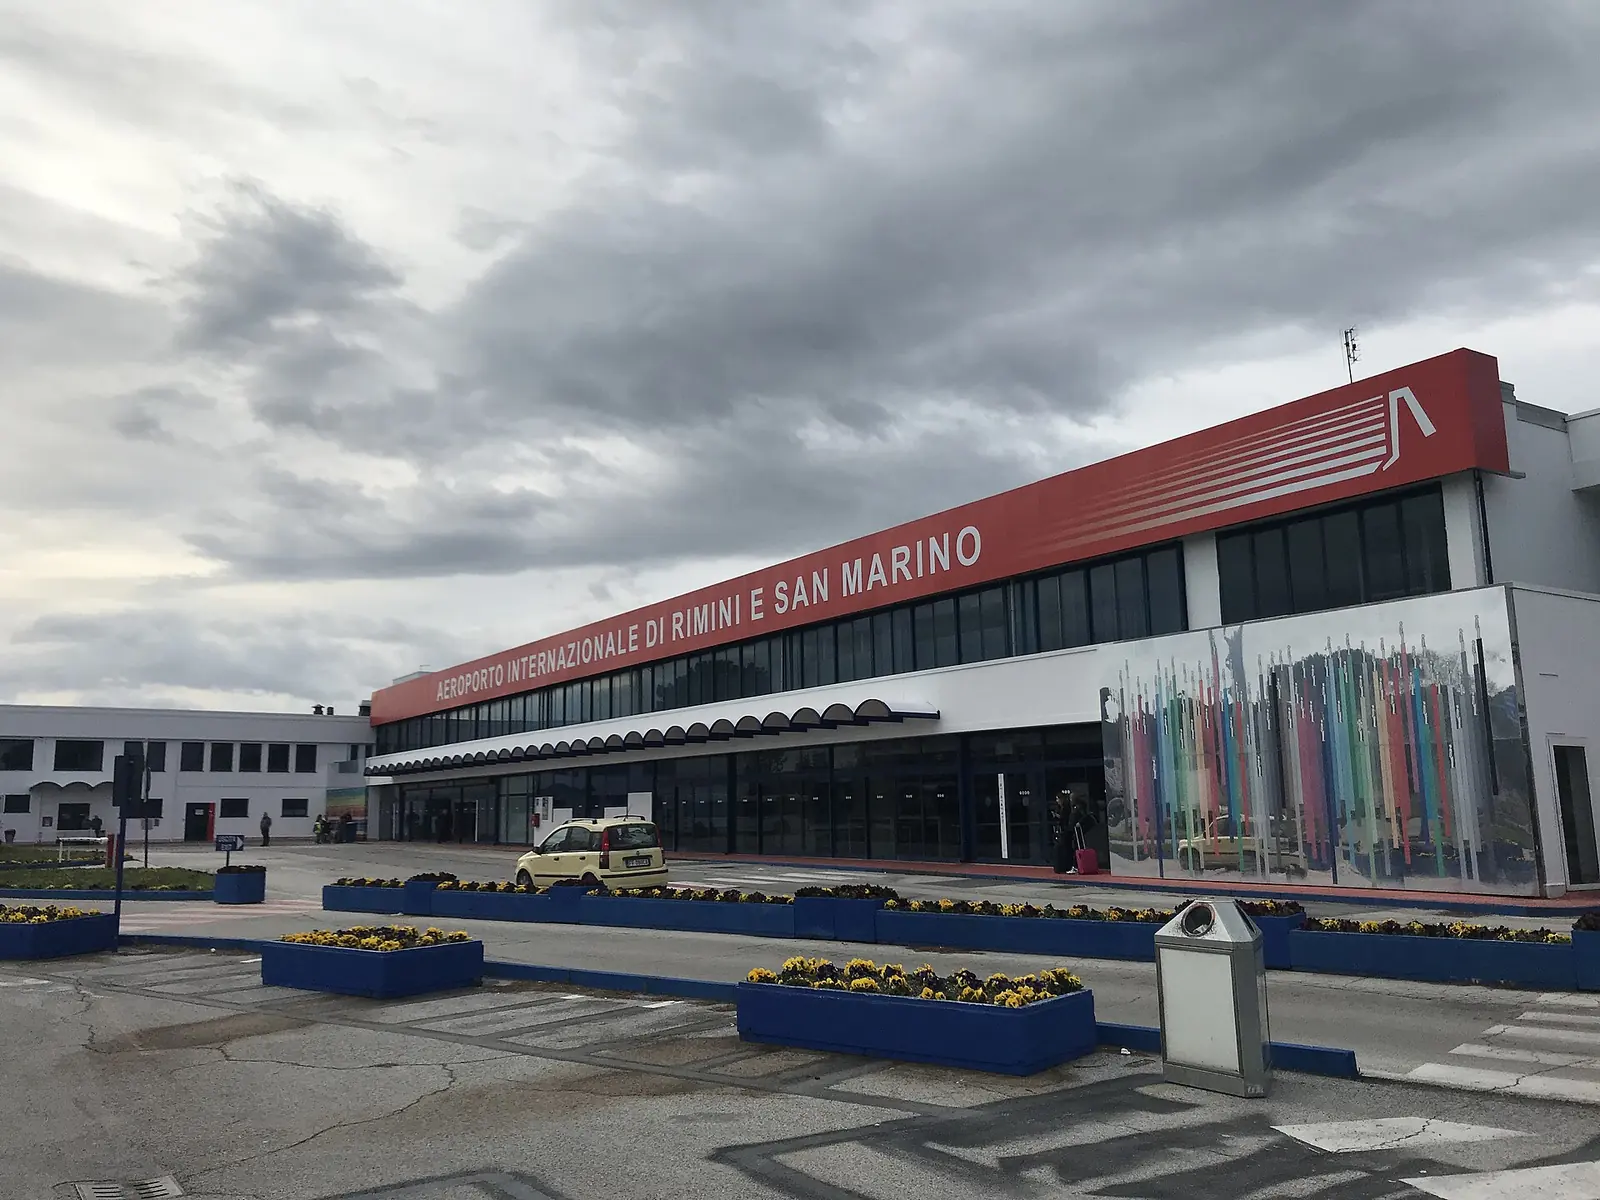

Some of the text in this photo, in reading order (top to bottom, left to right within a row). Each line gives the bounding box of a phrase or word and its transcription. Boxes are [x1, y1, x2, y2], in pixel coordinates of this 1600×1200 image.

[436, 525, 982, 702] AEROPORTO INTERNAZIONALE DI RIMINI E SAN MARINO
